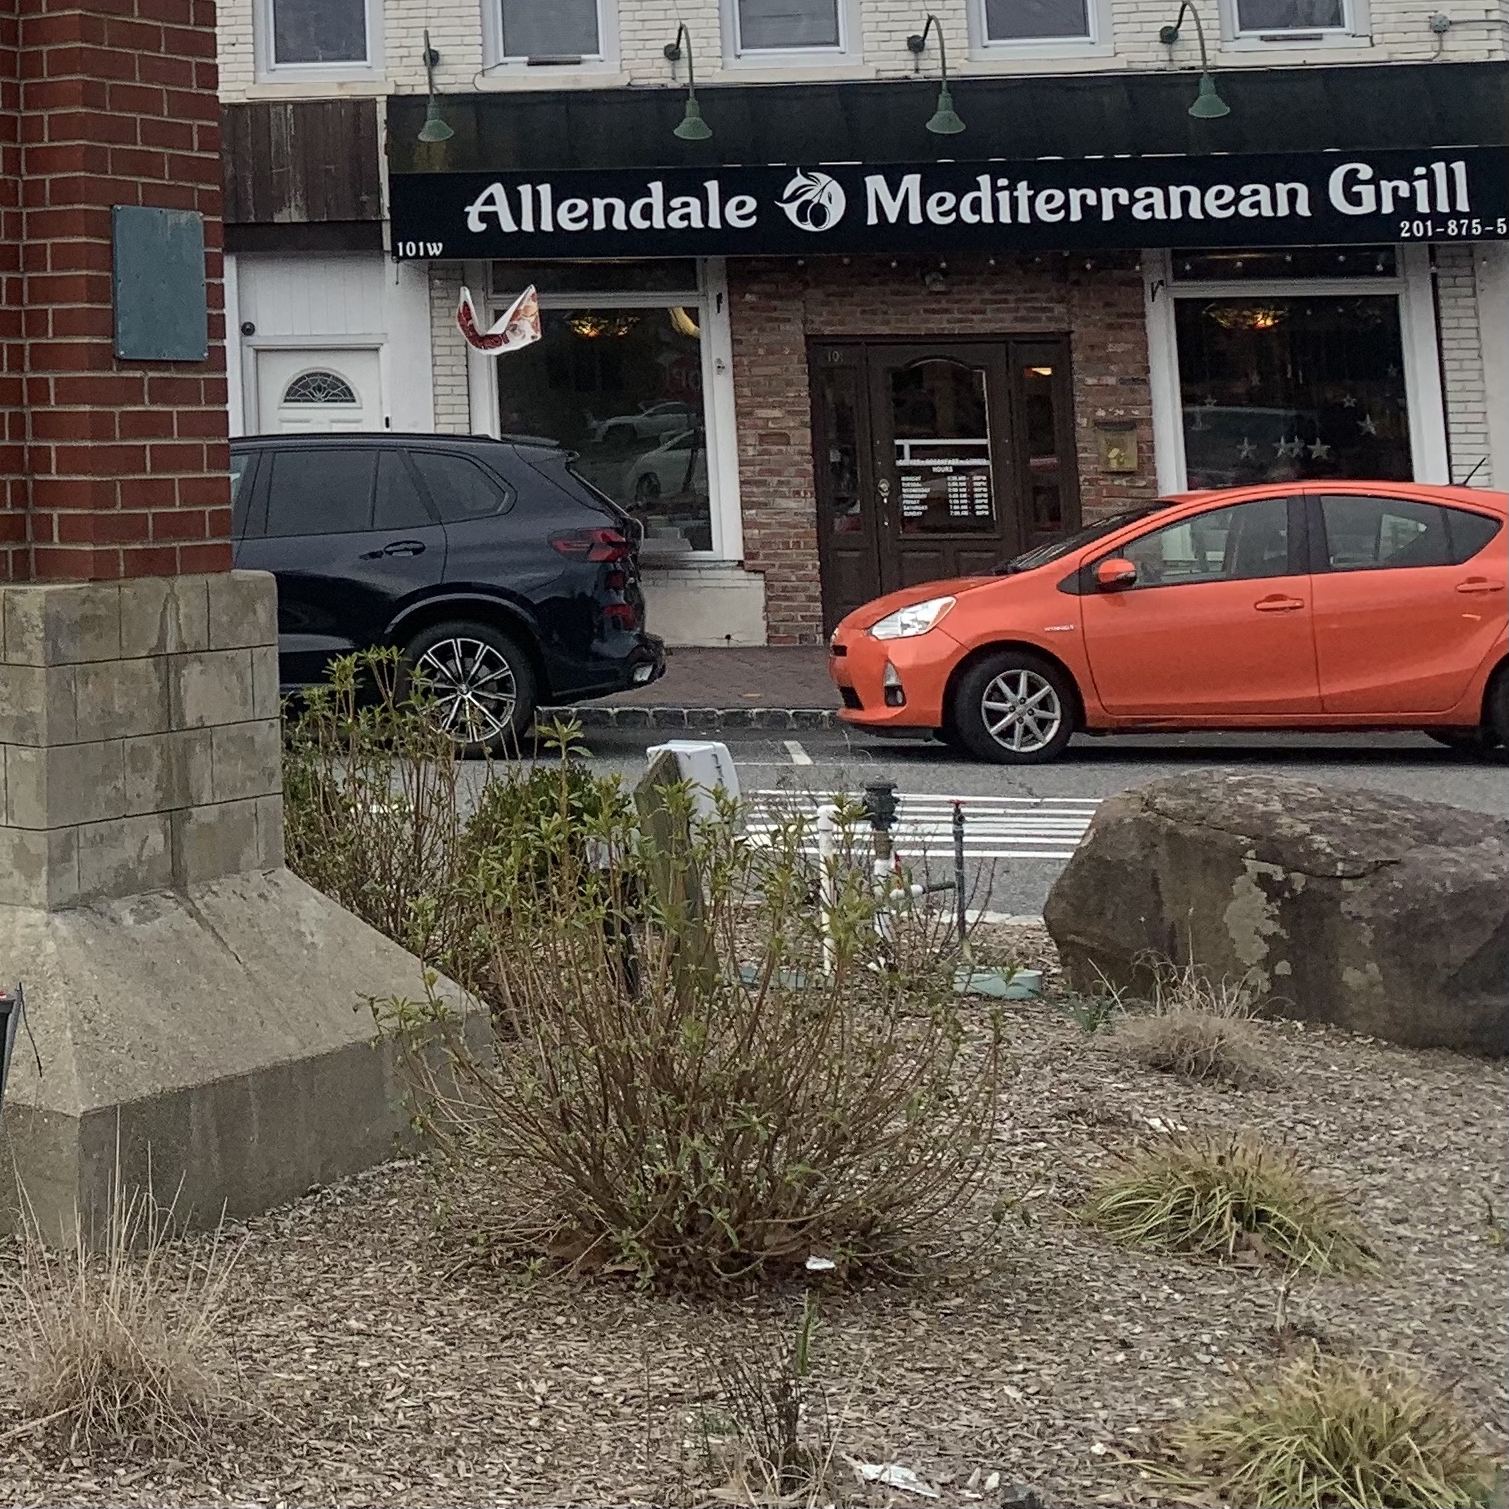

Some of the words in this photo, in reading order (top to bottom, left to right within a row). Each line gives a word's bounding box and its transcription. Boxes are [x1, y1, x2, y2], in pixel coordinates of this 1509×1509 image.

[464, 179, 758, 233] Allendale
[864, 173, 1312, 226] Mediterranean
[1328, 160, 1471, 216] Grill
